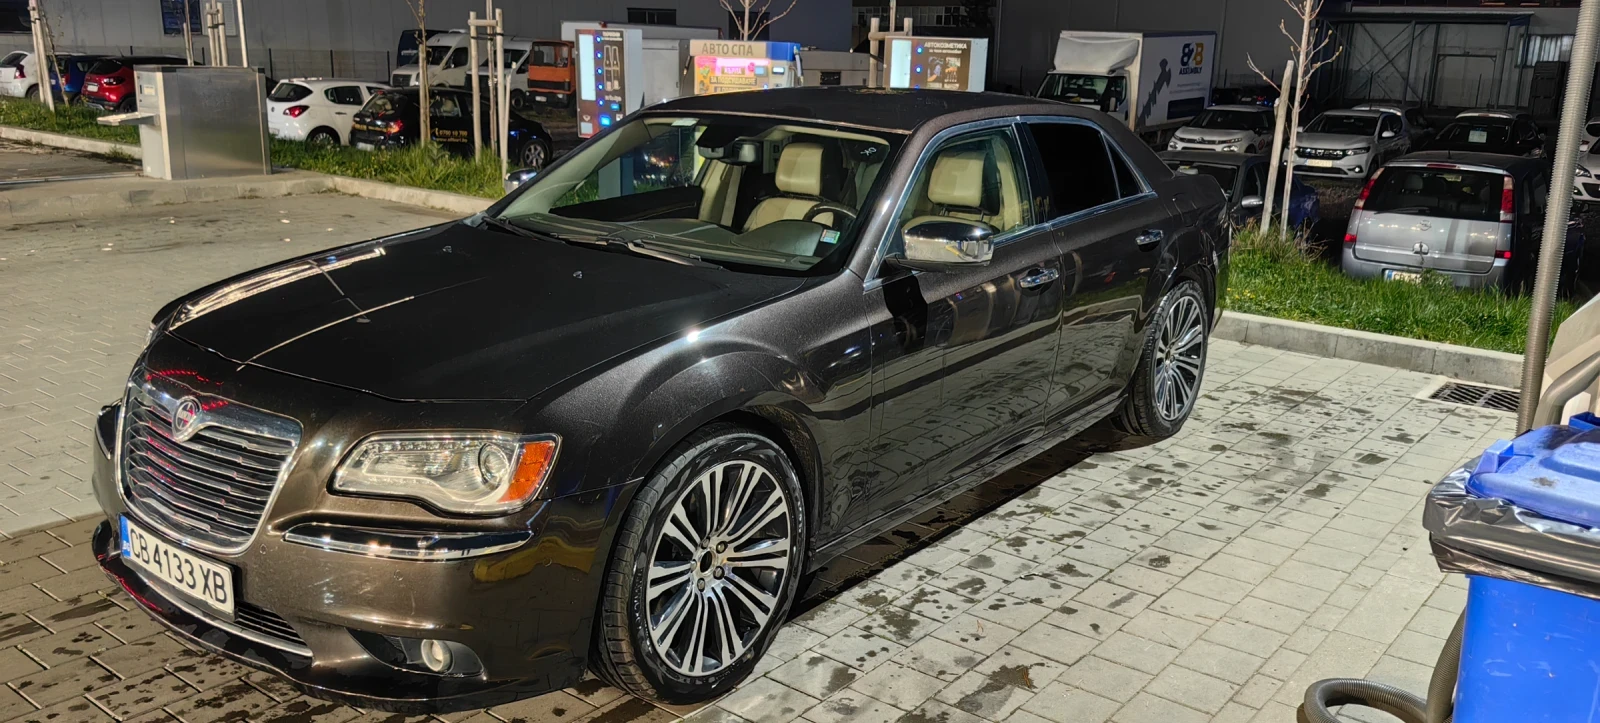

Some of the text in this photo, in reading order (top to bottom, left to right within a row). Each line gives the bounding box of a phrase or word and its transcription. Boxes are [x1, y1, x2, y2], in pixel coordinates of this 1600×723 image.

[702, 43, 753, 56] АВТО СПА
[1179, 67, 1202, 75] ASSEMBLY
[130, 528, 227, 604] CB 4133 XB
